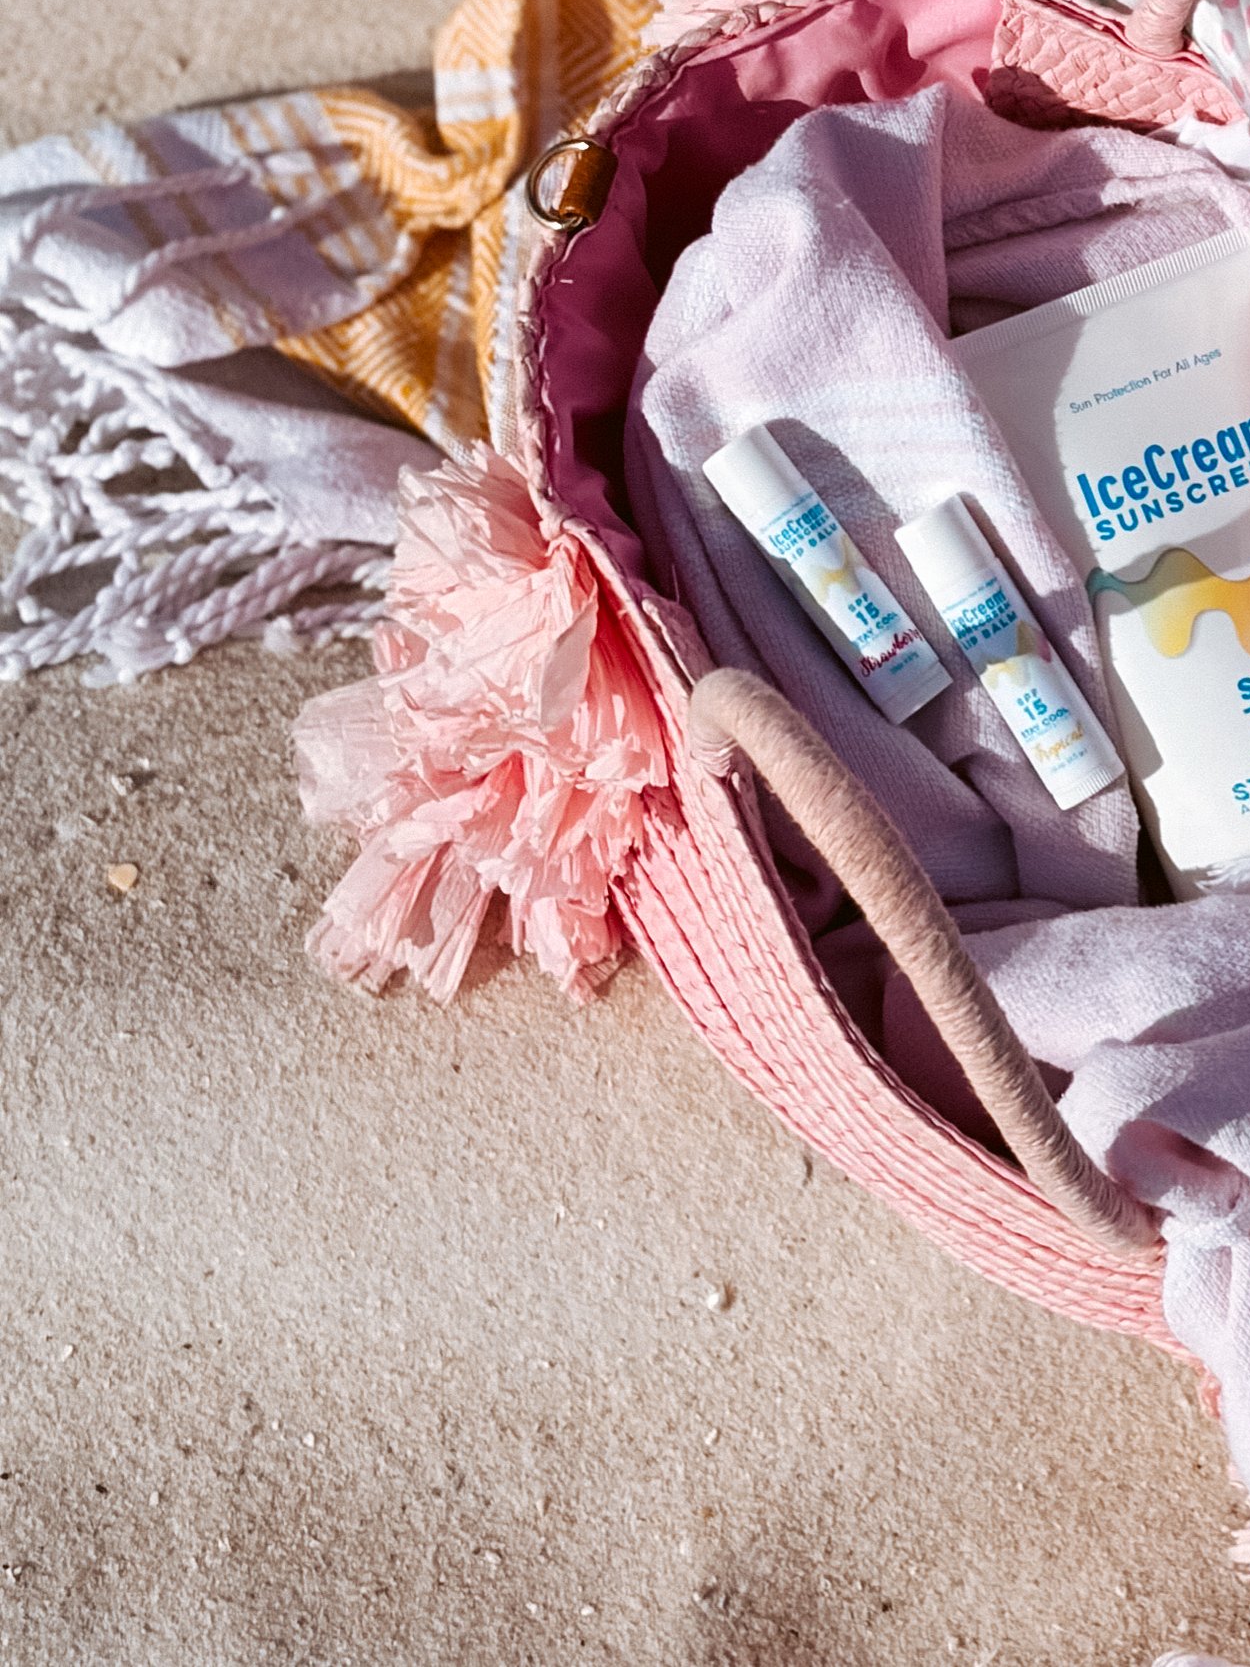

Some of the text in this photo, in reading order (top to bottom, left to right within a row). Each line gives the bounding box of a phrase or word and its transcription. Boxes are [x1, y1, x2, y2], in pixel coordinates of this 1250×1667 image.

[1069, 348, 1222, 414] Sun Protection For All Ages
[855, 602, 880, 626] 15
[1024, 698, 1047, 720] 15
